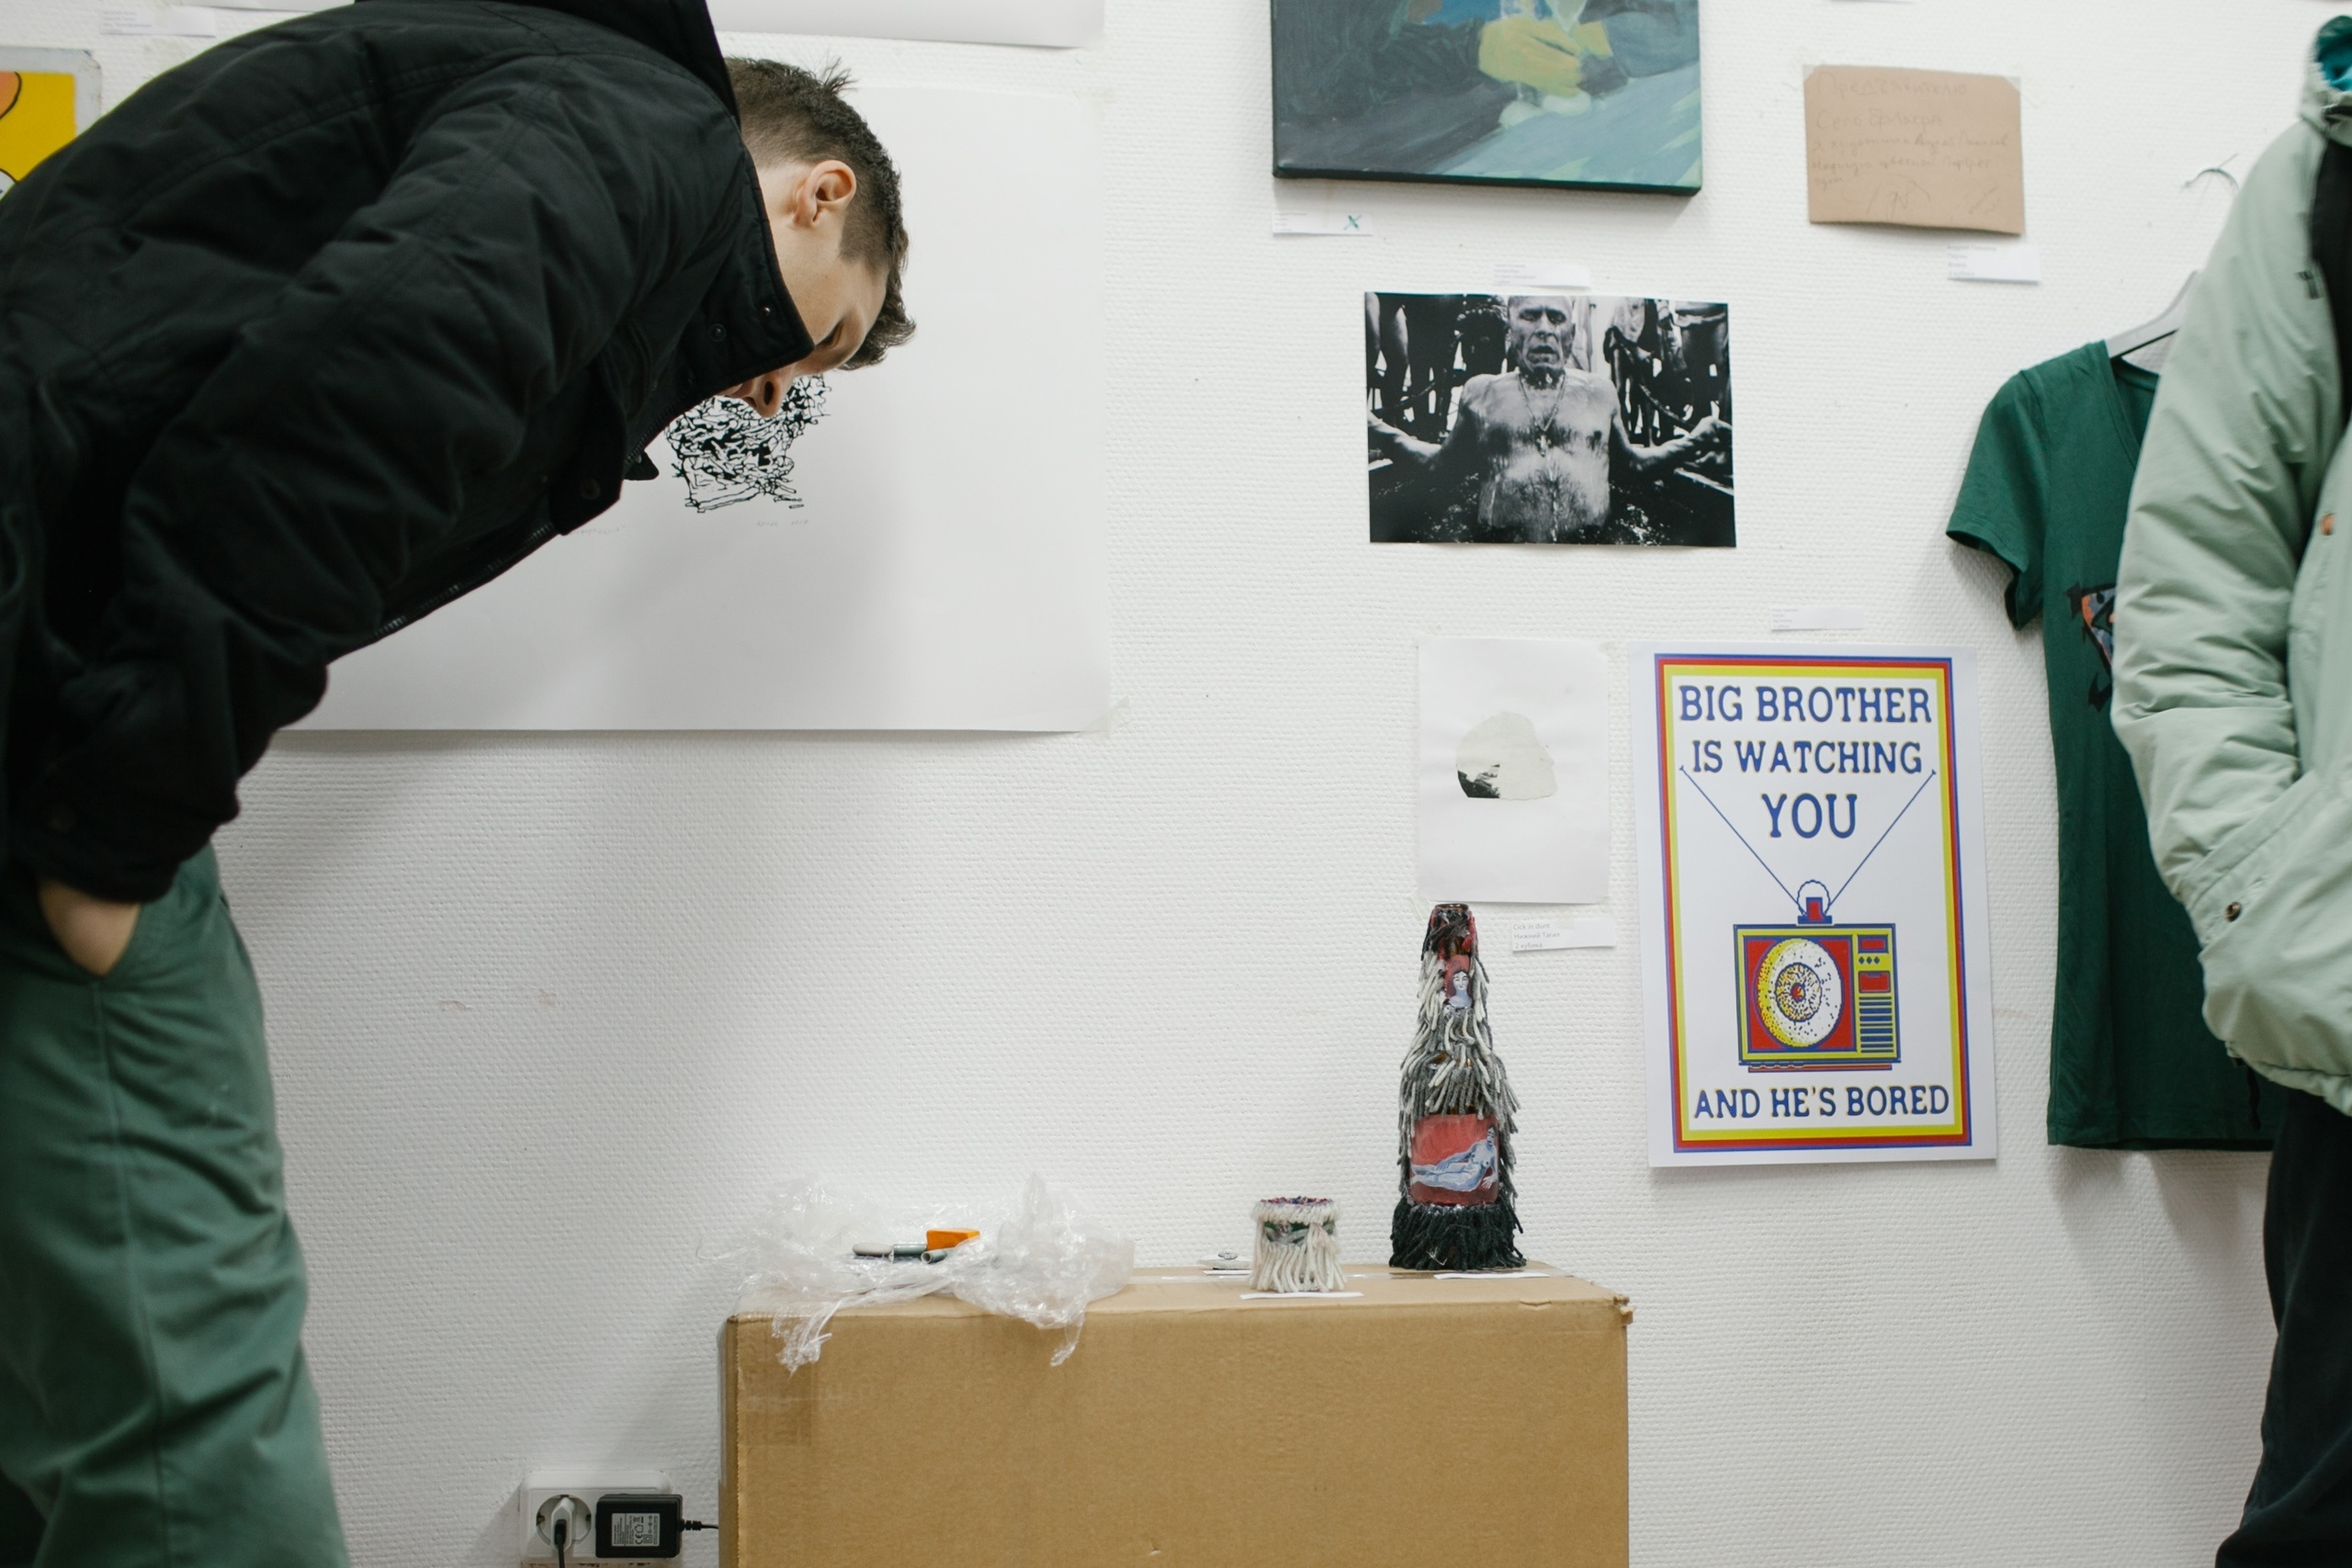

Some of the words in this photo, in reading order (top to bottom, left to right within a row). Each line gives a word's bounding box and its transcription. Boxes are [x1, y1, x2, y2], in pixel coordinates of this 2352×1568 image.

[1679, 685, 1744, 722] BIG
[1756, 686, 1932, 723] BROTHER
[1694, 741, 1723, 773] IS
[1736, 741, 1922, 773] WATCHING
[1762, 794, 1857, 839] YOU
[1694, 1089, 1761, 1119] AND
[1770, 1086, 1837, 1118] HE'S
[1847, 1085, 1950, 1116] BORED
